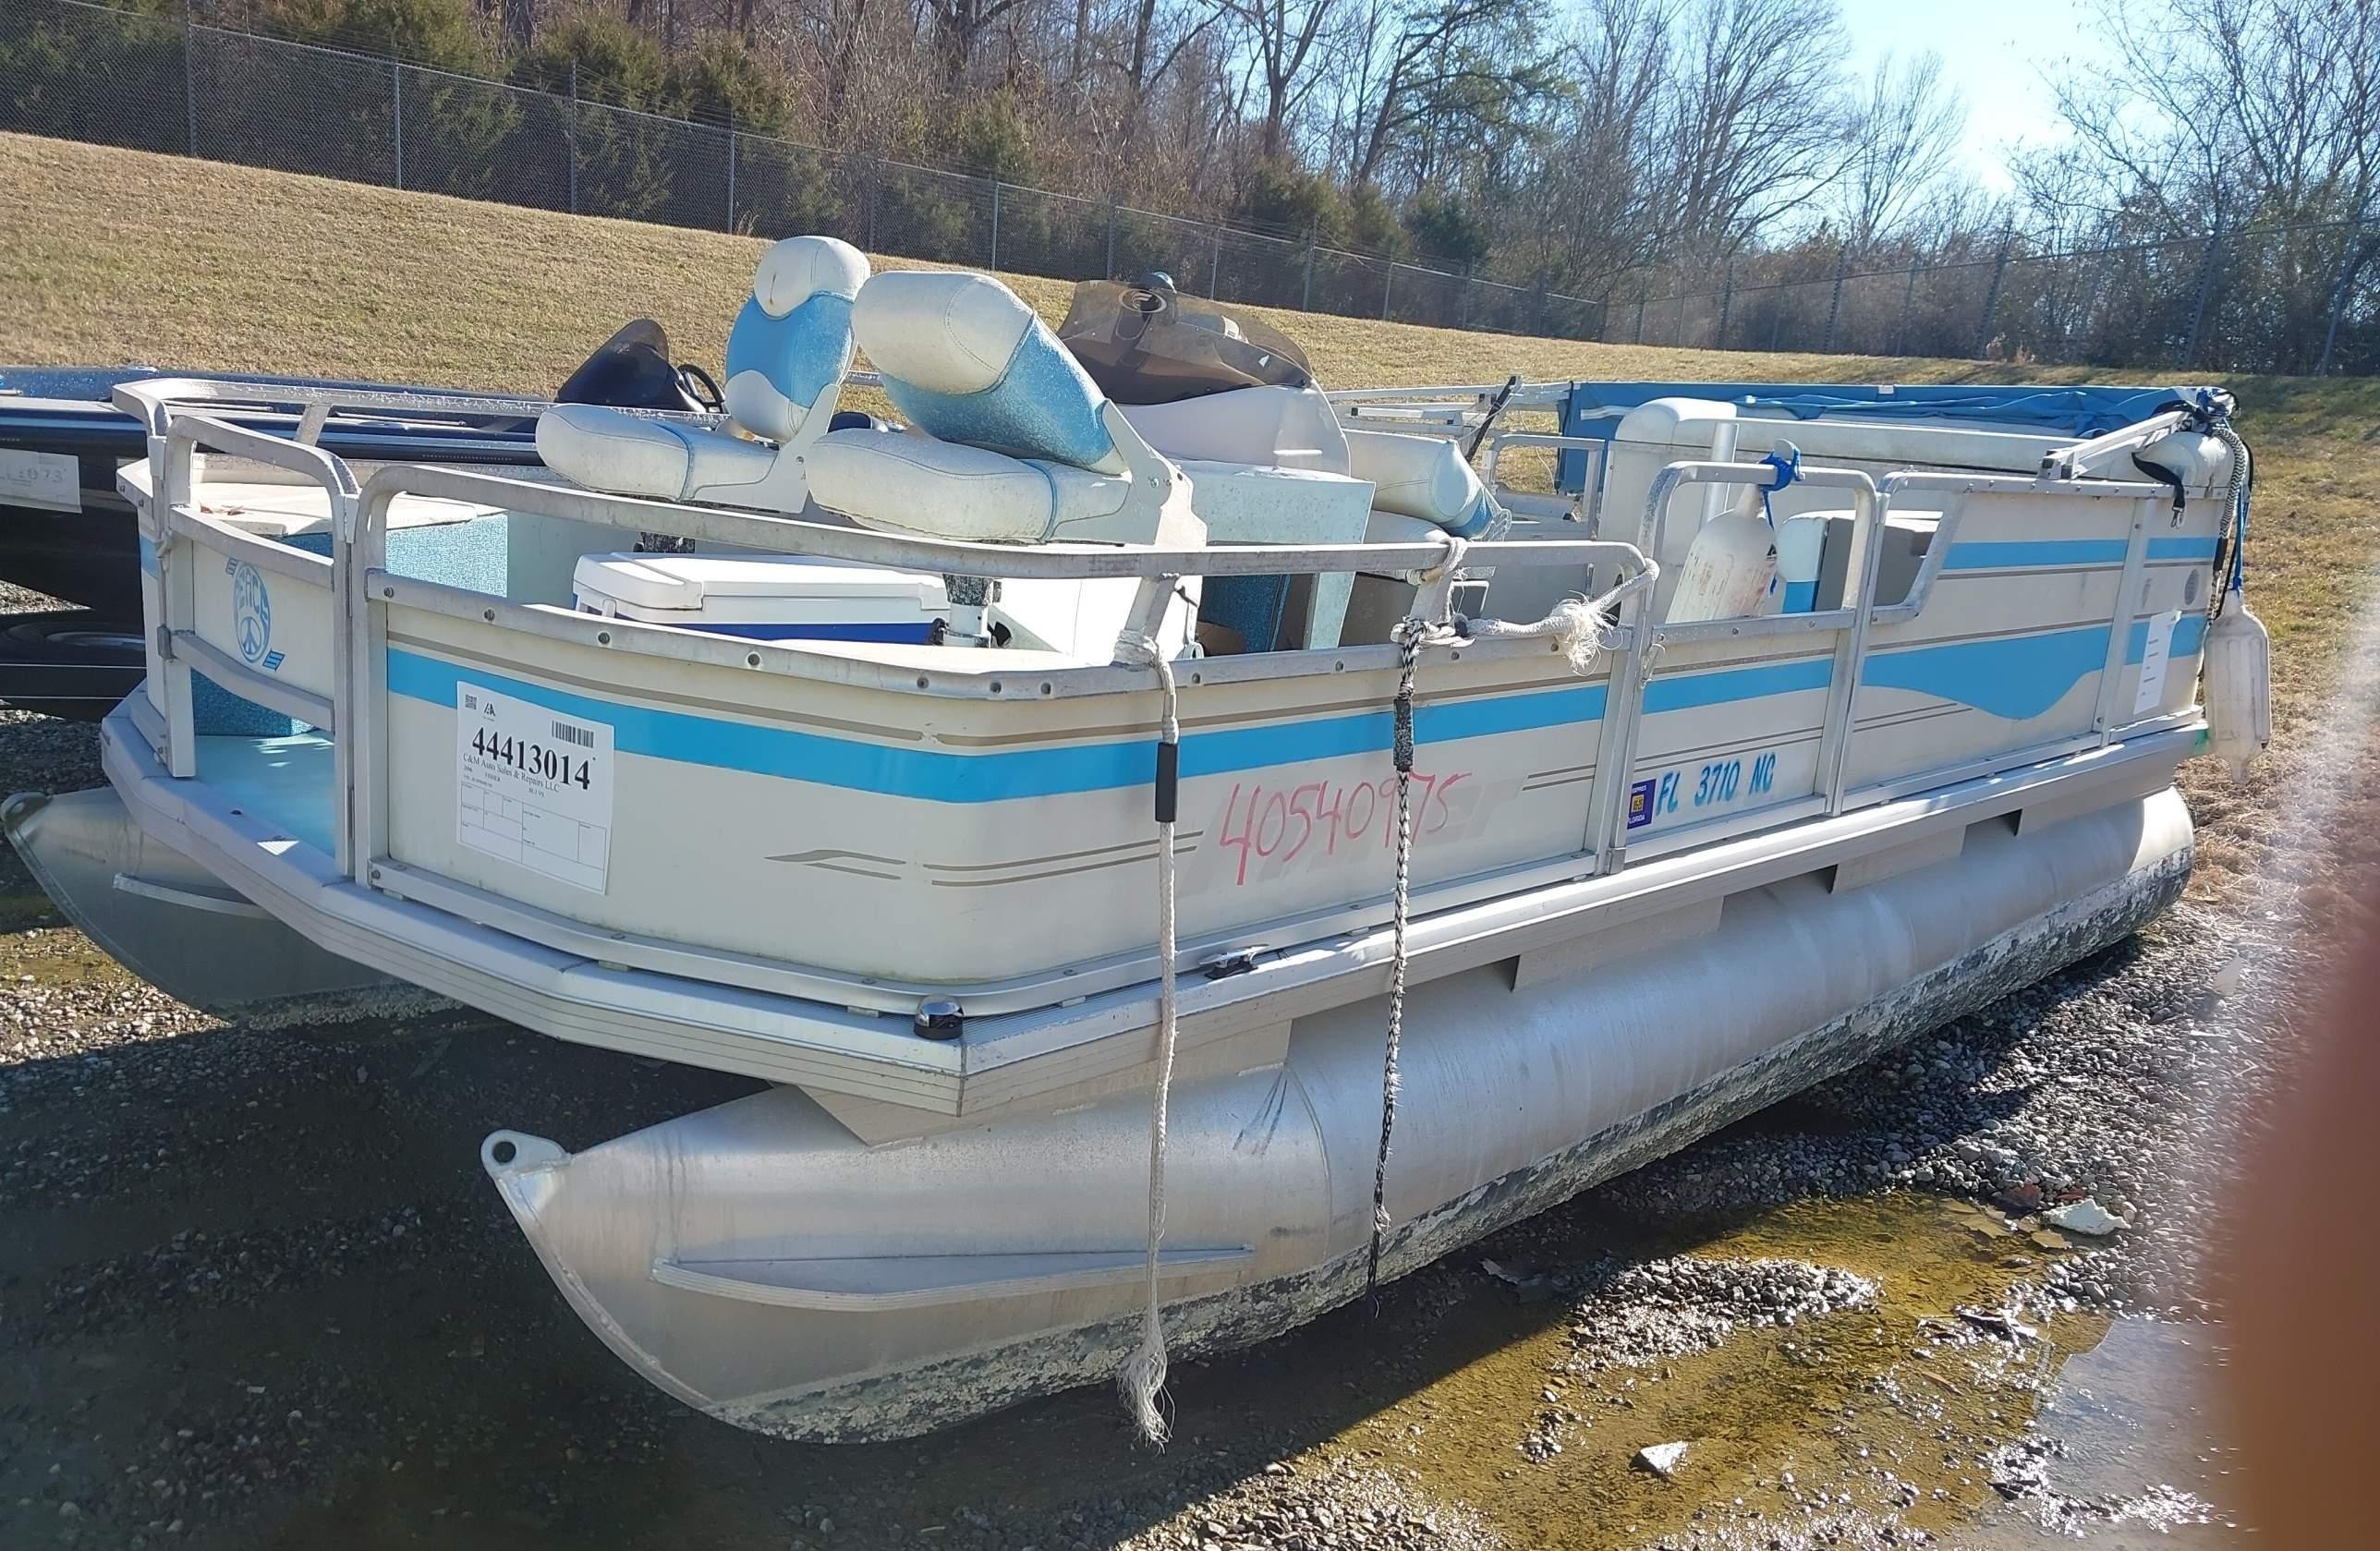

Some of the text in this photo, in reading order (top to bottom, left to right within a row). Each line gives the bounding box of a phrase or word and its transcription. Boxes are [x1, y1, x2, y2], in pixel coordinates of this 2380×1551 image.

[472, 727, 590, 790] 44413014
[481, 760, 496, 770] Auto
[497, 764, 512, 776] Sales
[521, 772, 544, 787] Repairs
[545, 780, 561, 793] LLC
[1656, 770, 1680, 816] FL
[1694, 758, 1741, 806] 3710
[1219, 768, 1473, 886] 40540975
